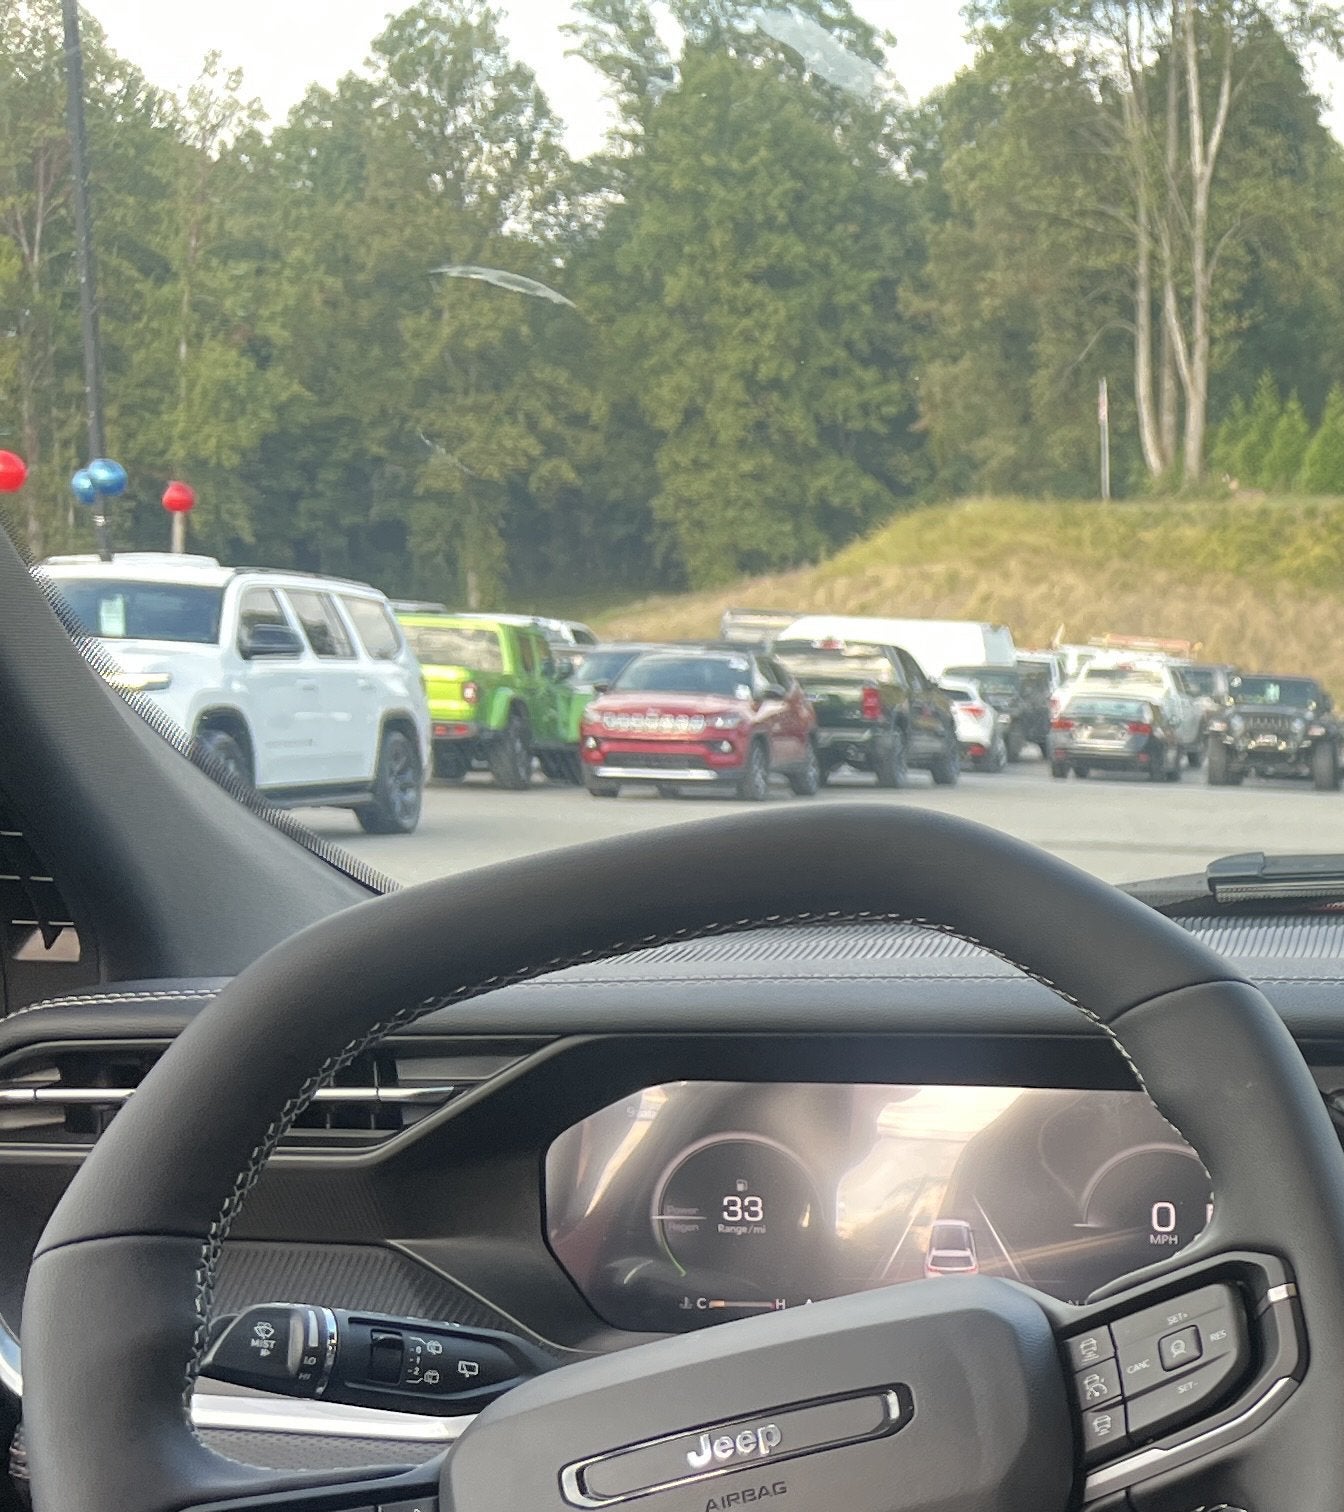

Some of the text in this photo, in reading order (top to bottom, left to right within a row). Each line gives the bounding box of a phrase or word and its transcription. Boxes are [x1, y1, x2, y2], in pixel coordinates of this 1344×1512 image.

[723, 1195, 764, 1221] 33
[1152, 1202, 1176, 1232] 0
[718, 1224, 766, 1235] Range/mi
[1150, 1235, 1178, 1245] MPH
[696, 1298, 707, 1309] C
[775, 1298, 786, 1309] H
[1209, 1329, 1227, 1342] RES
[250, 1338, 277, 1349] MIST
[303, 1356, 317, 1365] LO
[1126, 1358, 1150, 1374] CANC
[686, 1423, 782, 1468] Jeep
[704, 1481, 787, 1512] AIRBAG
